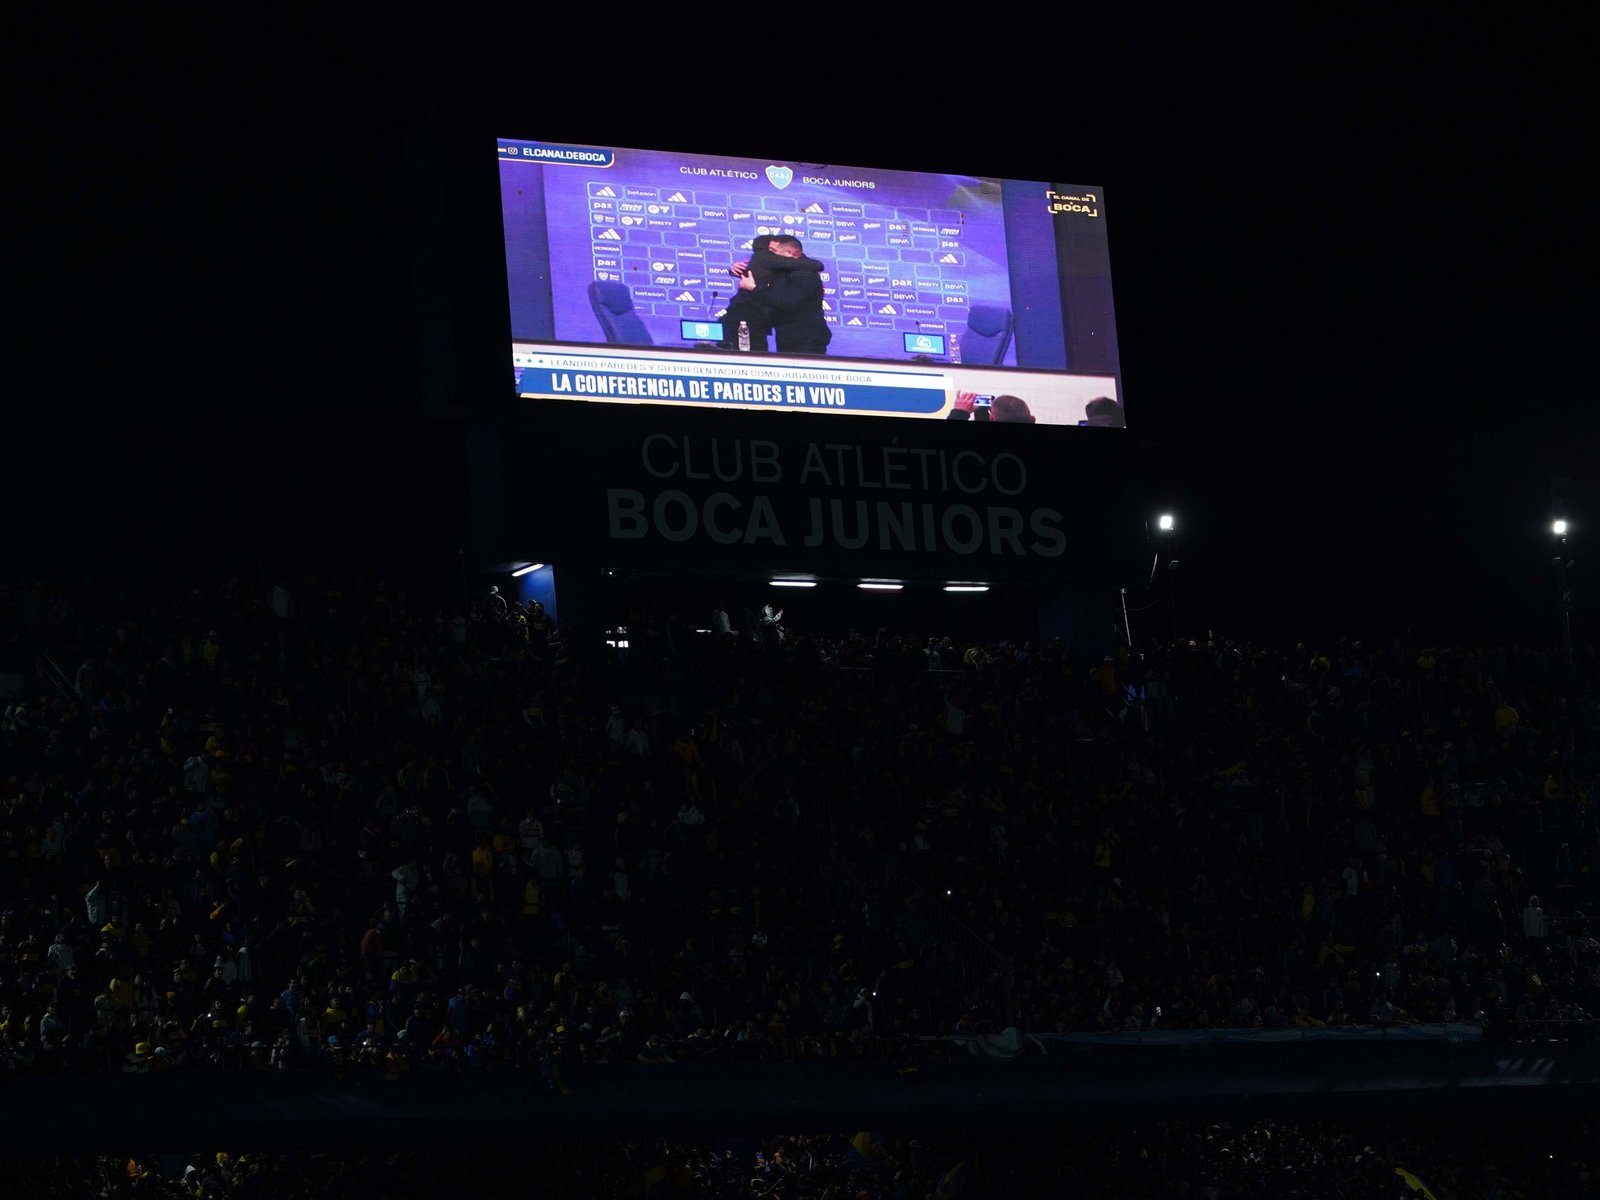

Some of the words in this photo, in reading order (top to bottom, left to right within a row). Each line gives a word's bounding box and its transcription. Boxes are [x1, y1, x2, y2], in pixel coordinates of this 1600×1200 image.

[523, 147, 606, 162] ELCANALDEBOCA
[680, 166, 707, 176] CLUB
[709, 169, 758, 180] ATLÉTICO
[803, 176, 830, 185] BOCA
[832, 180, 876, 189] JUNIORS
[1053, 203, 1091, 213] BOCA
[889, 223, 907, 231] pax
[892, 279, 913, 287] pax
[550, 359, 597, 368] LEANDRO
[601, 362, 646, 371] PAREDES
[657, 364, 671, 372] SU
[751, 369, 780, 378] COMO
[782, 372, 829, 380] JUGADOR
[552, 373, 572, 392] LA
[575, 374, 686, 398] CONFERENCIA
[689, 380, 710, 399] DE
[713, 381, 782, 402] PAREDES
[786, 385, 806, 404] EN
[809, 387, 846, 406] VIVO
[641, 433, 783, 484] CLUB
[800, 436, 1028, 496] ATLÉTICO
[606, 488, 787, 546] BOCA
[803, 498, 1068, 558] JUNIORS
